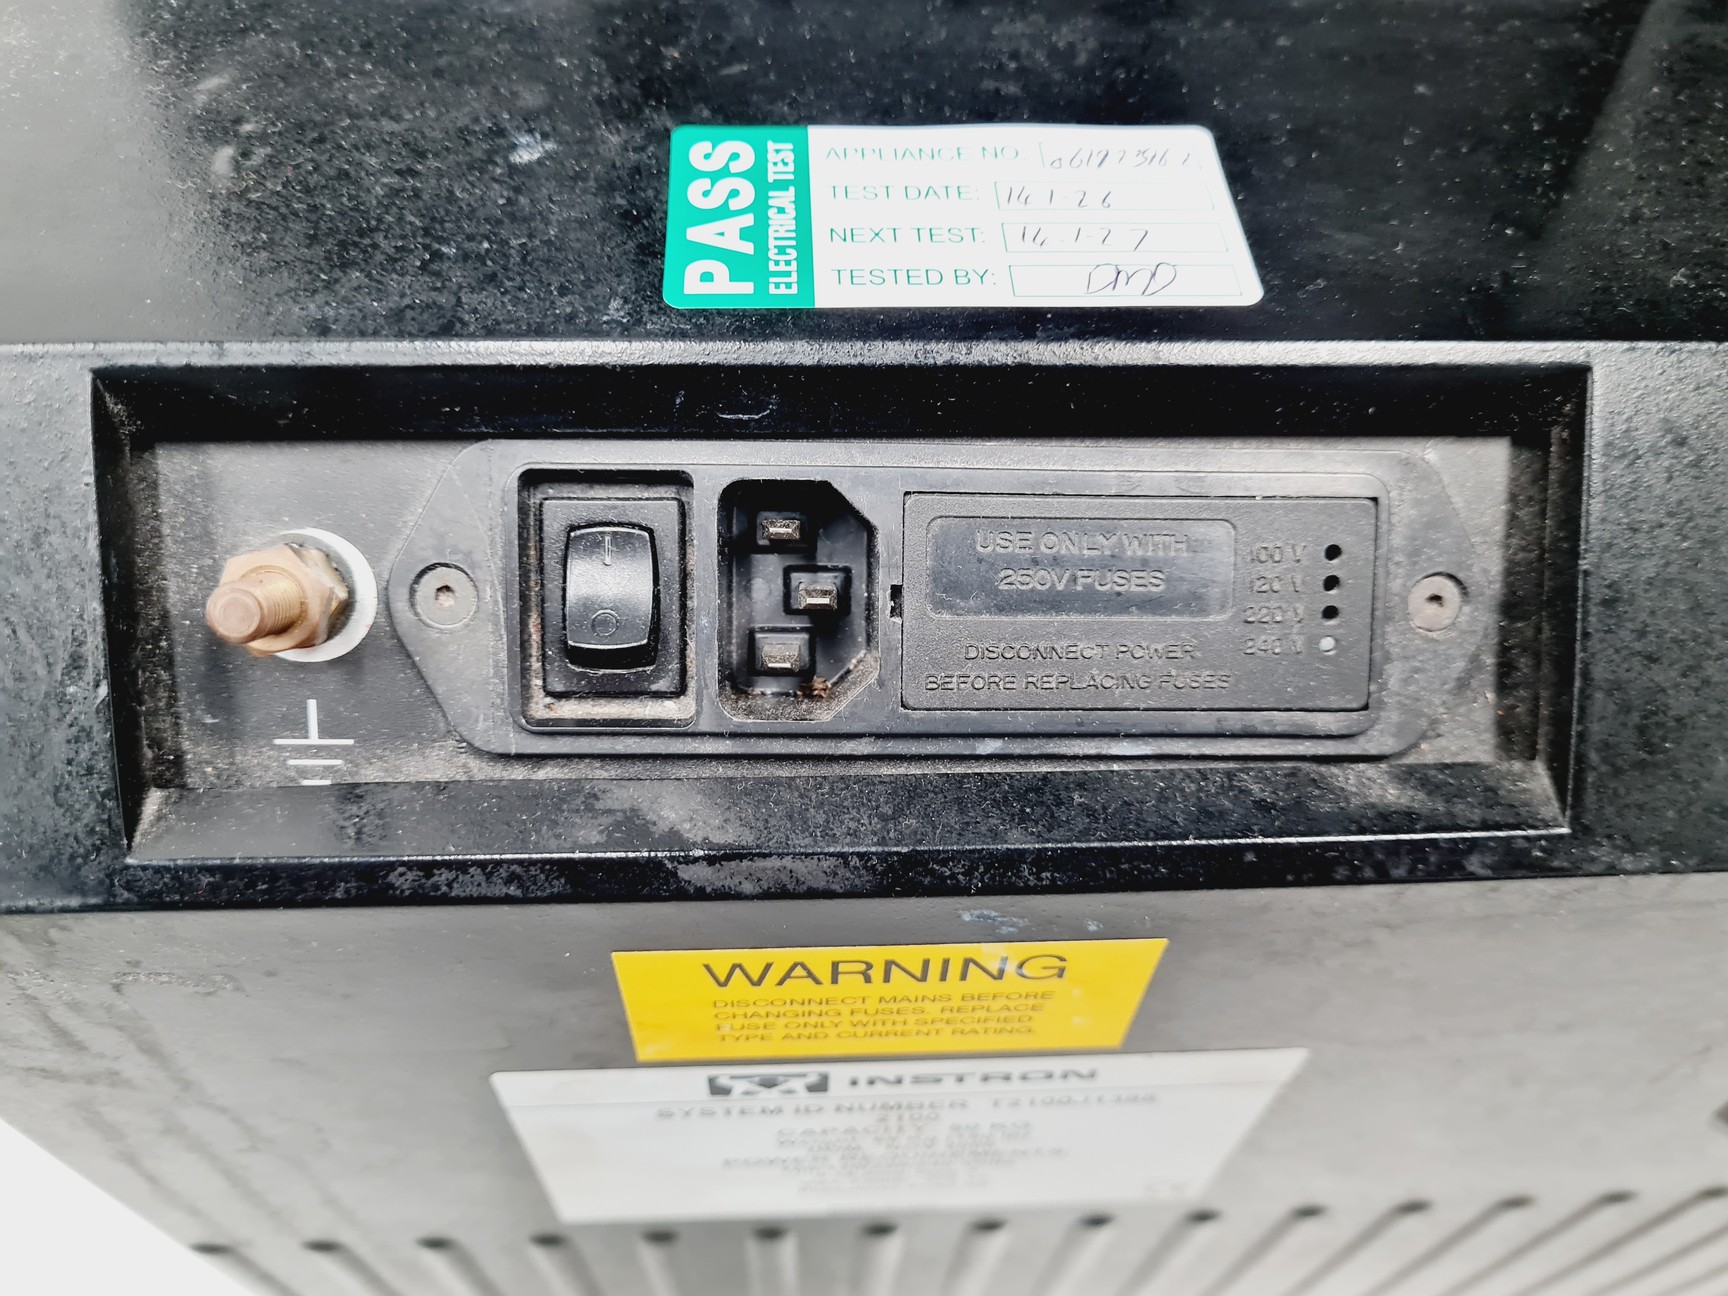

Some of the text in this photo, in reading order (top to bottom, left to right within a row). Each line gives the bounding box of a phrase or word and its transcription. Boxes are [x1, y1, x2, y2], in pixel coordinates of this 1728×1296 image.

[826, 147, 973, 161] APPLIANCE
[826, 185, 980, 201] TEST DATE:
[684, 140, 755, 294] PASS
[767, 140, 798, 294] ELECTRICAL TEST
[830, 227, 986, 243] NEXT TEST:
[831, 268, 997, 286] TESTED BY:
[976, 530, 1190, 556] USE ONLY WITH
[998, 567, 1166, 592] 250V FUSES
[964, 642, 1197, 661] DISCONNECT POWER
[924, 672, 1233, 691] BEFORE REPLACING FUSES
[702, 954, 1069, 988] WARNING
[713, 990, 1056, 1008] DISCONNECT MAINS BEFORE
[714, 1008, 842, 1020] CHANGING
[940, 1003, 1046, 1014] REPLACE
[717, 1014, 1033, 1032] FUSE ONLY WITH SPECIFIED
[719, 1032, 774, 1043] TYPE
[781, 1030, 829, 1041] AND
[836, 1027, 944, 1039] CURRENT
[849, 1068, 1097, 1086] INSTRON
